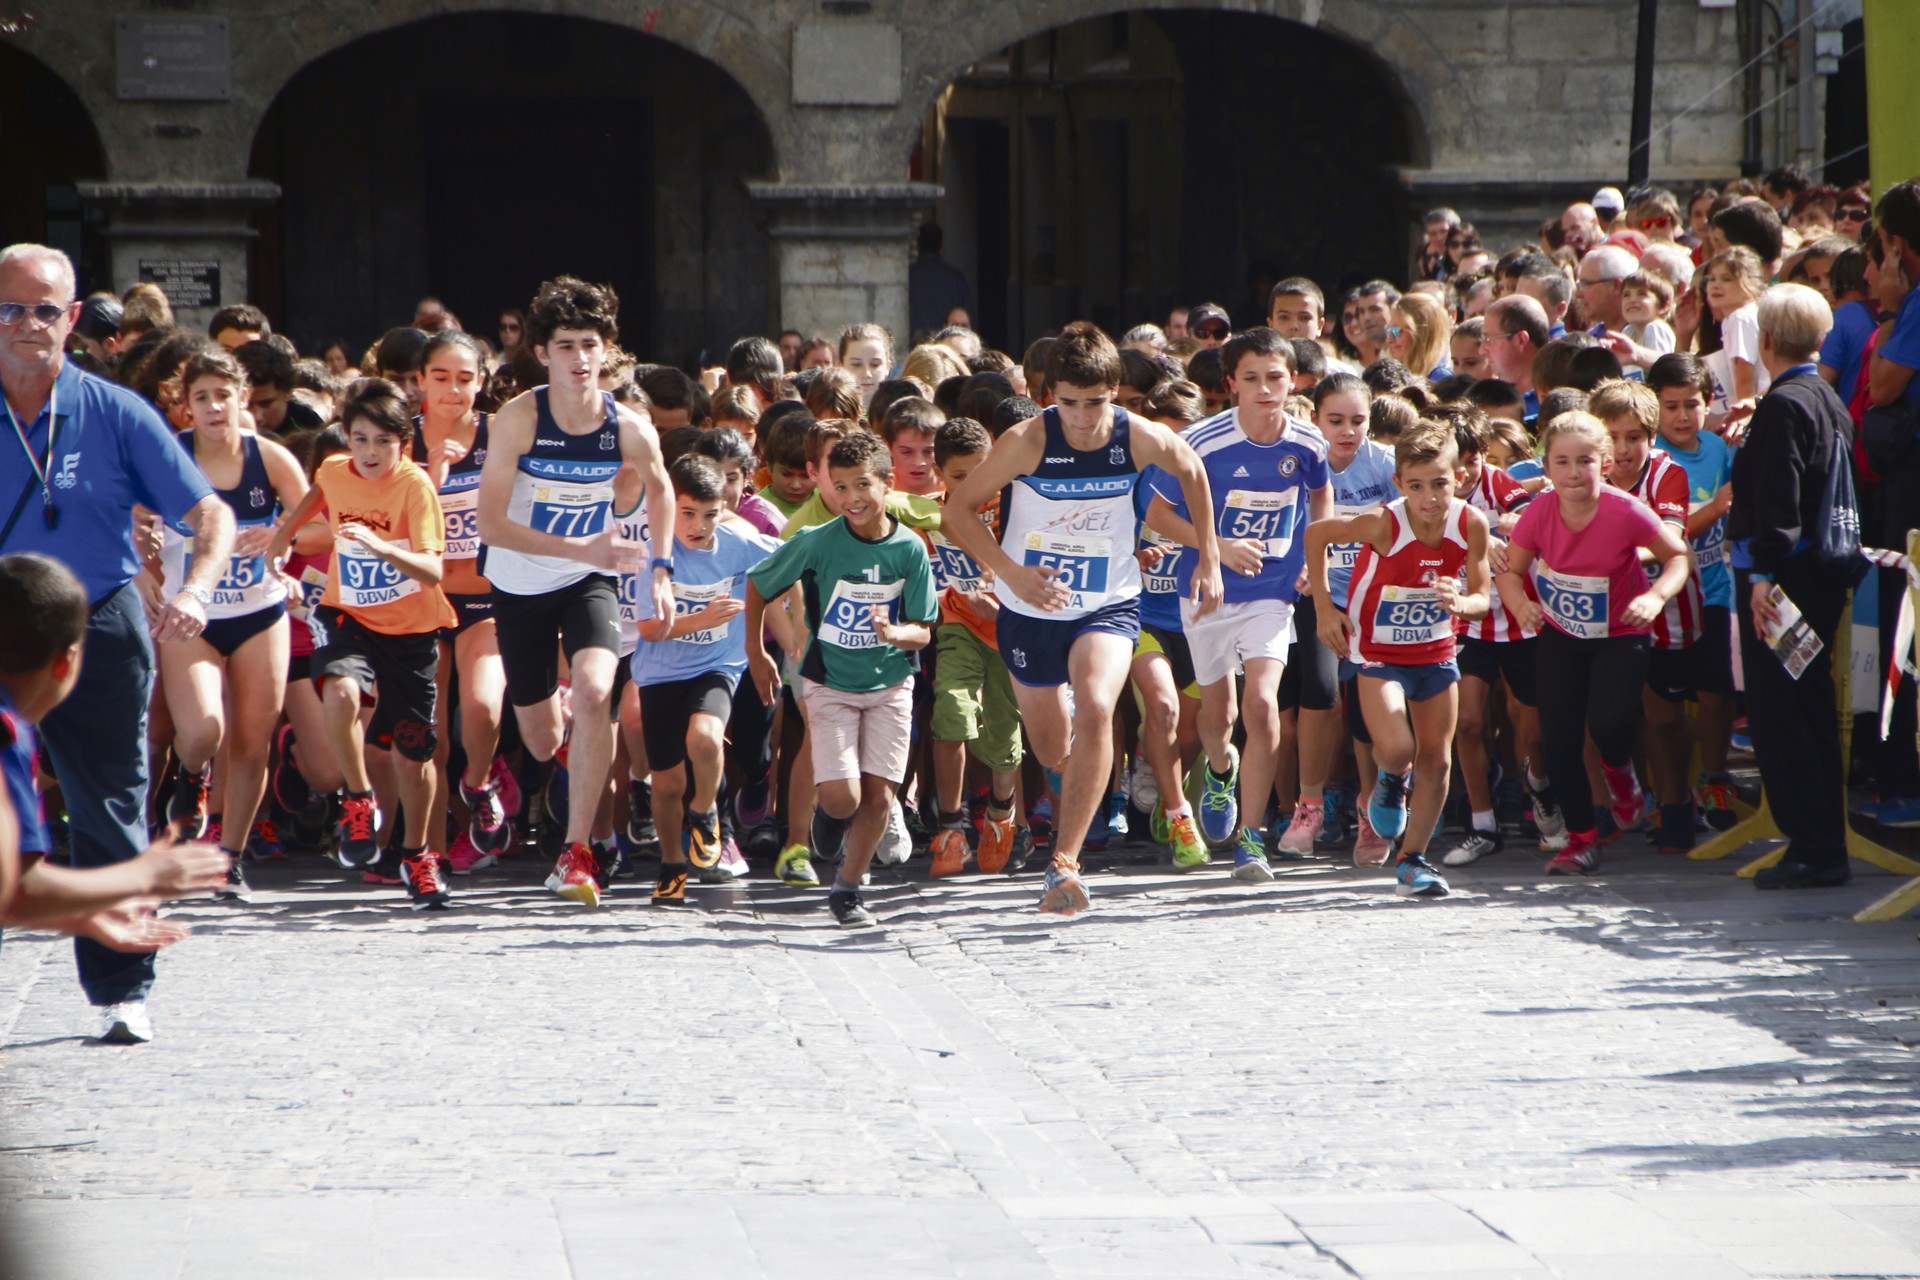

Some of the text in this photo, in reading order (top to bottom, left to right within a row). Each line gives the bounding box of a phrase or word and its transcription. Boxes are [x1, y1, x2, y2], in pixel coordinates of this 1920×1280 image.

[1039, 479, 1131, 493] C.A.LAUDIO
[546, 506, 599, 537] 777
[1232, 511, 1281, 541] 541
[347, 560, 401, 588] 979
[1039, 555, 1090, 589] 551
[356, 588, 400, 605] BBVA
[1545, 583, 1594, 621] 763
[836, 601, 872, 631] 92
[1389, 601, 1442, 625] 863
[838, 631, 879, 647] BBVA
[1392, 627, 1433, 642] BBVA
